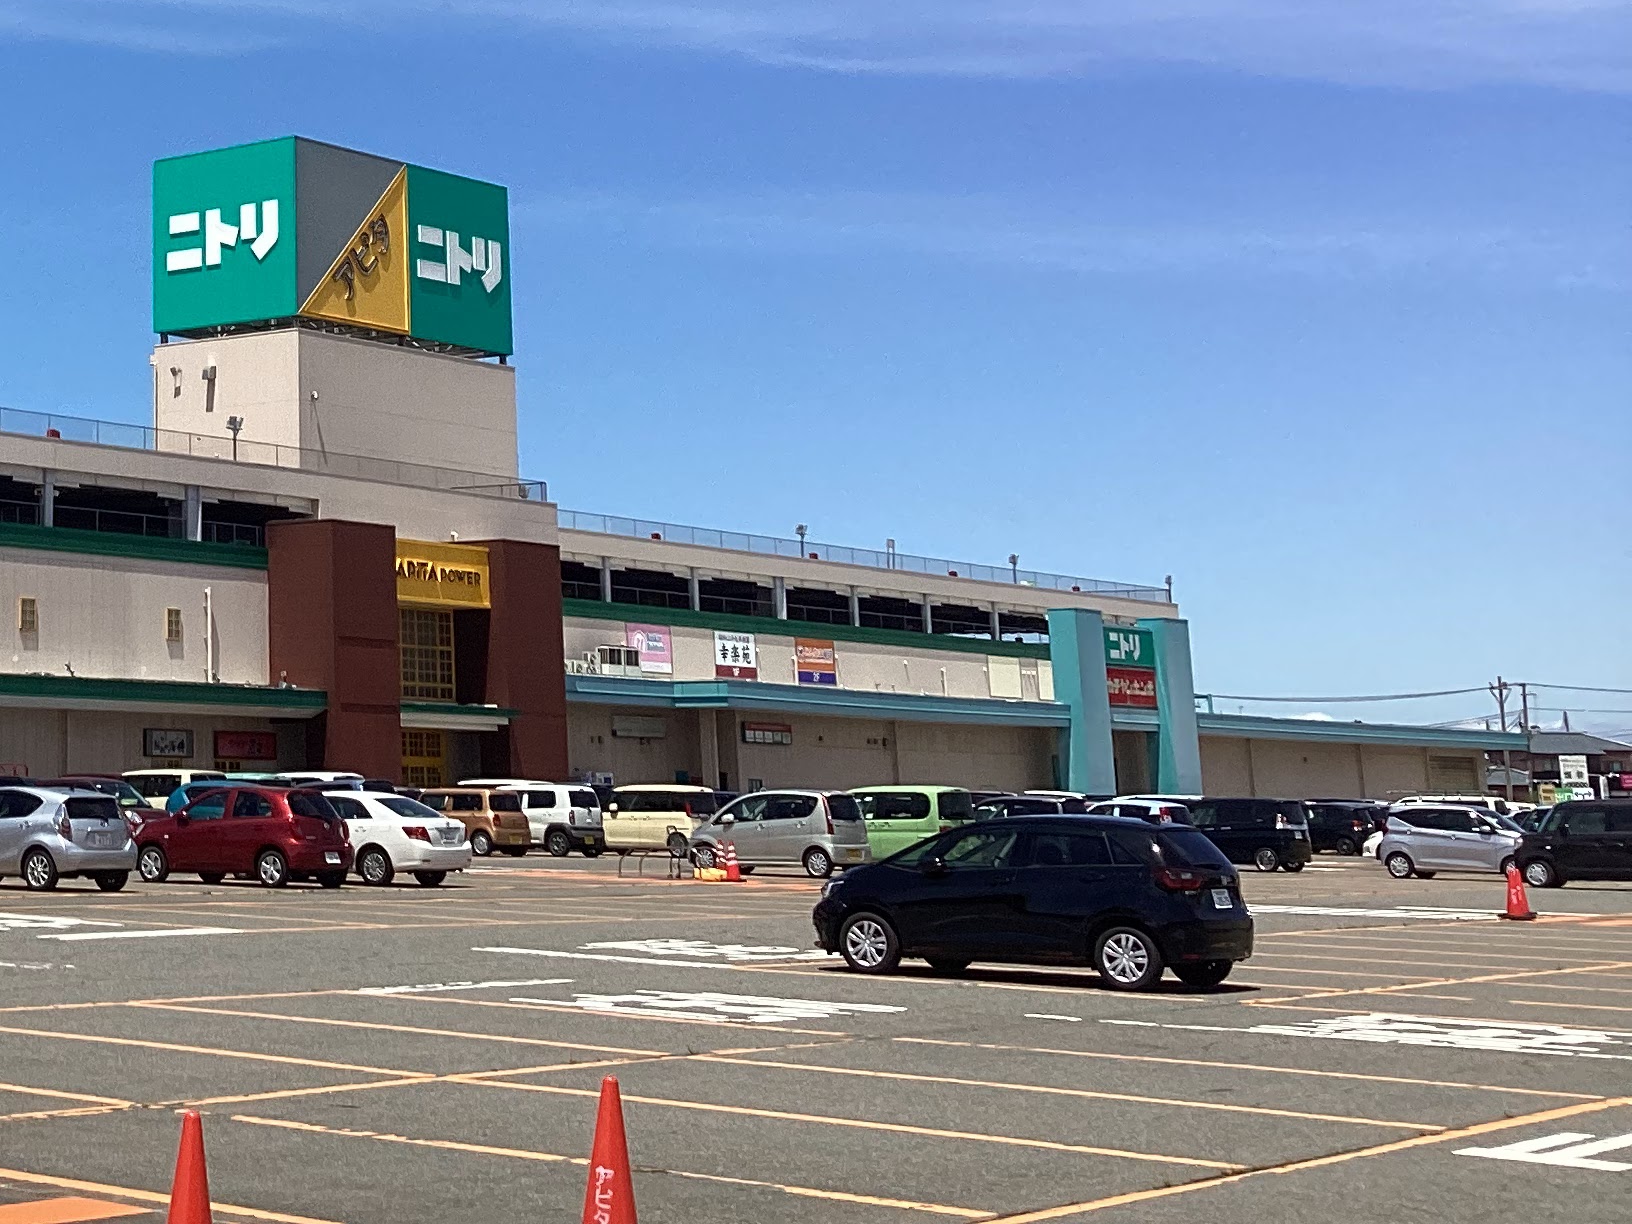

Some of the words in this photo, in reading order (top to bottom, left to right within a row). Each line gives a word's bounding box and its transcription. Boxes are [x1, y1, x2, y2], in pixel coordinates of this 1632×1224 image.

[166, 198, 279, 272] ニトリ
[332, 212, 390, 301] アピタ
[416, 223, 502, 294] ニトリ
[439, 566, 482, 587] POWER
[718, 642, 752, 665] 幸楽苑
[1109, 631, 1142, 661] ニトリ
